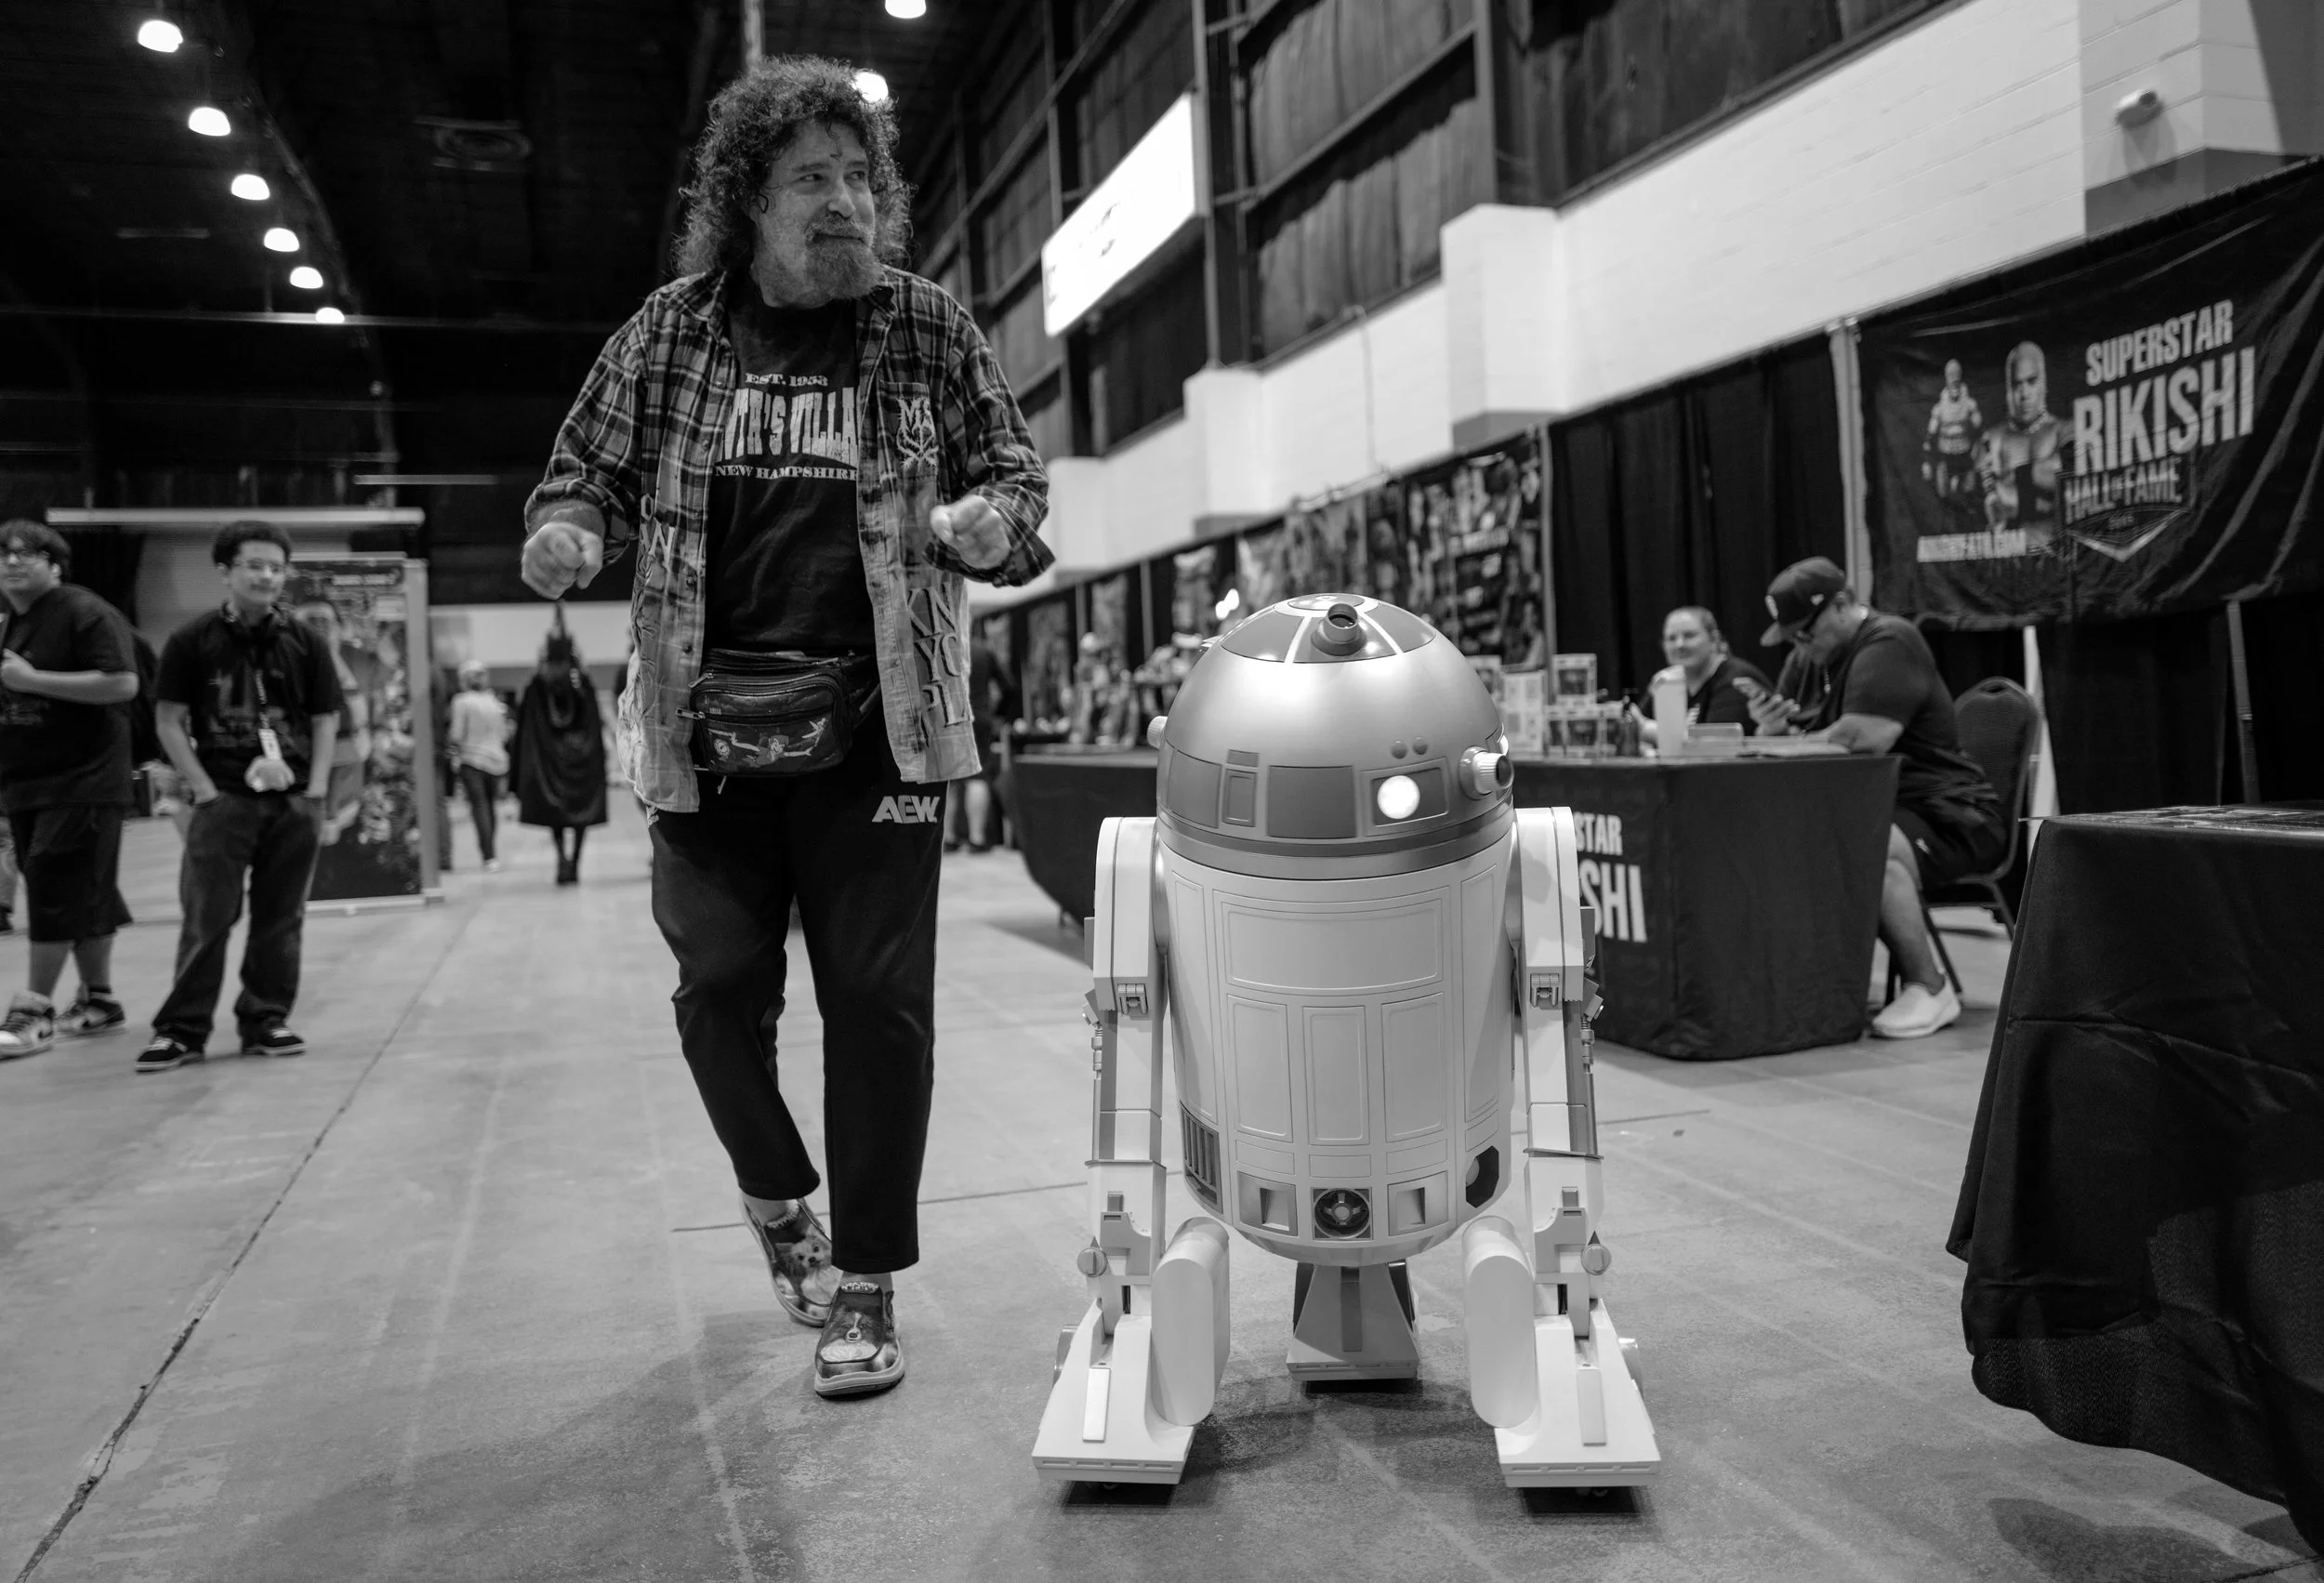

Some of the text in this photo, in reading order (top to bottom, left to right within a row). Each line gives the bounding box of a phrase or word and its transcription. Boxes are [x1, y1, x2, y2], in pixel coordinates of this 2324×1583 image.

[2085, 299, 2234, 386] SUPERSTAR
[745, 373, 786, 385] EST.
[2073, 346, 2256, 476] RIKISHI
[714, 465, 754, 477] NEW
[2064, 473, 2116, 524] HALL
[2124, 456, 2183, 506] FAME
[871, 794, 941, 824] AEW
